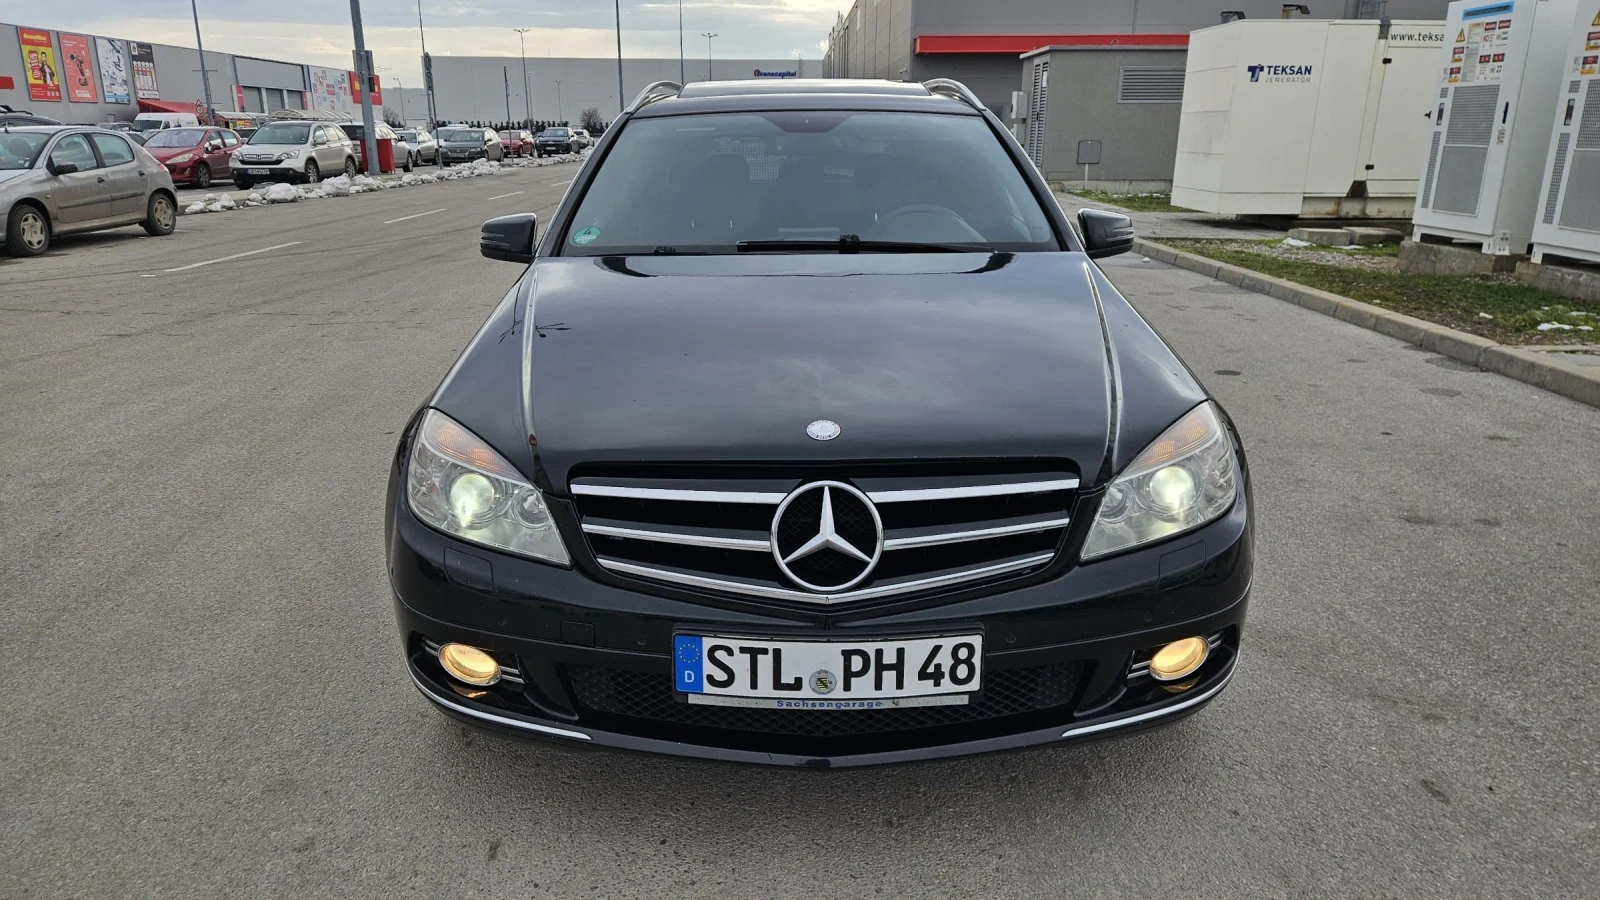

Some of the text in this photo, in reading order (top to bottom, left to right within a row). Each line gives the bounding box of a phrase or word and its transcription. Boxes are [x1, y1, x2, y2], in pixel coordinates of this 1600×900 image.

[1266, 65, 1312, 75] TEKSAN
[684, 671, 695, 683] D
[706, 644, 803, 692] STL
[841, 647, 906, 692] PH
[917, 642, 976, 687] 48
[777, 700, 883, 709] Sachsengarage
